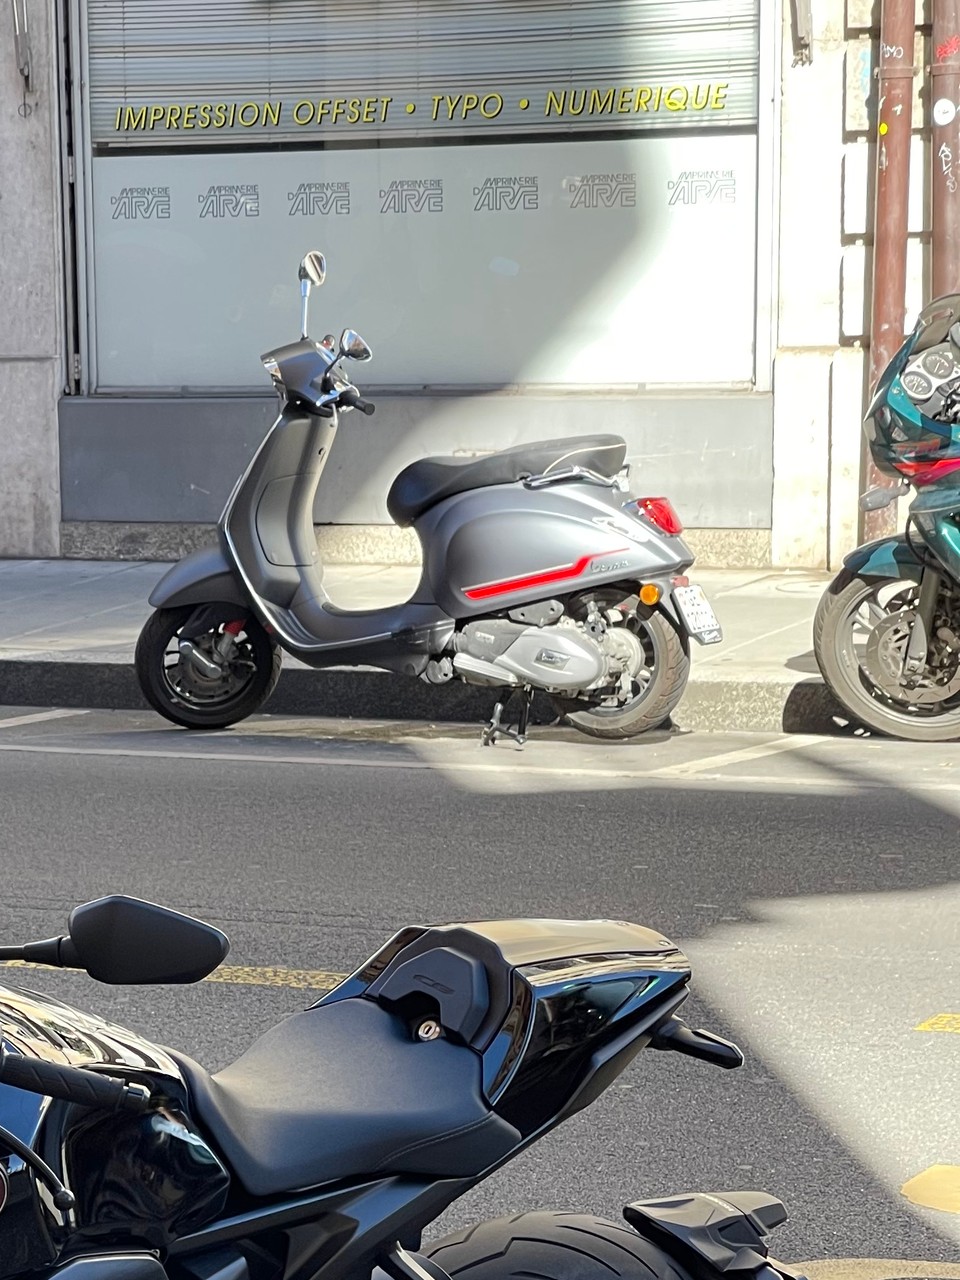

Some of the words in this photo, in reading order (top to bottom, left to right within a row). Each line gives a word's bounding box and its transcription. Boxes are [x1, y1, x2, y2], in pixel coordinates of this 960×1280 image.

[114, 101, 282, 131] IMPRESSION
[292, 97, 392, 126] OFFSET
[431, 93, 504, 120] TYPO
[544, 82, 729, 117] NUMERIQUE
